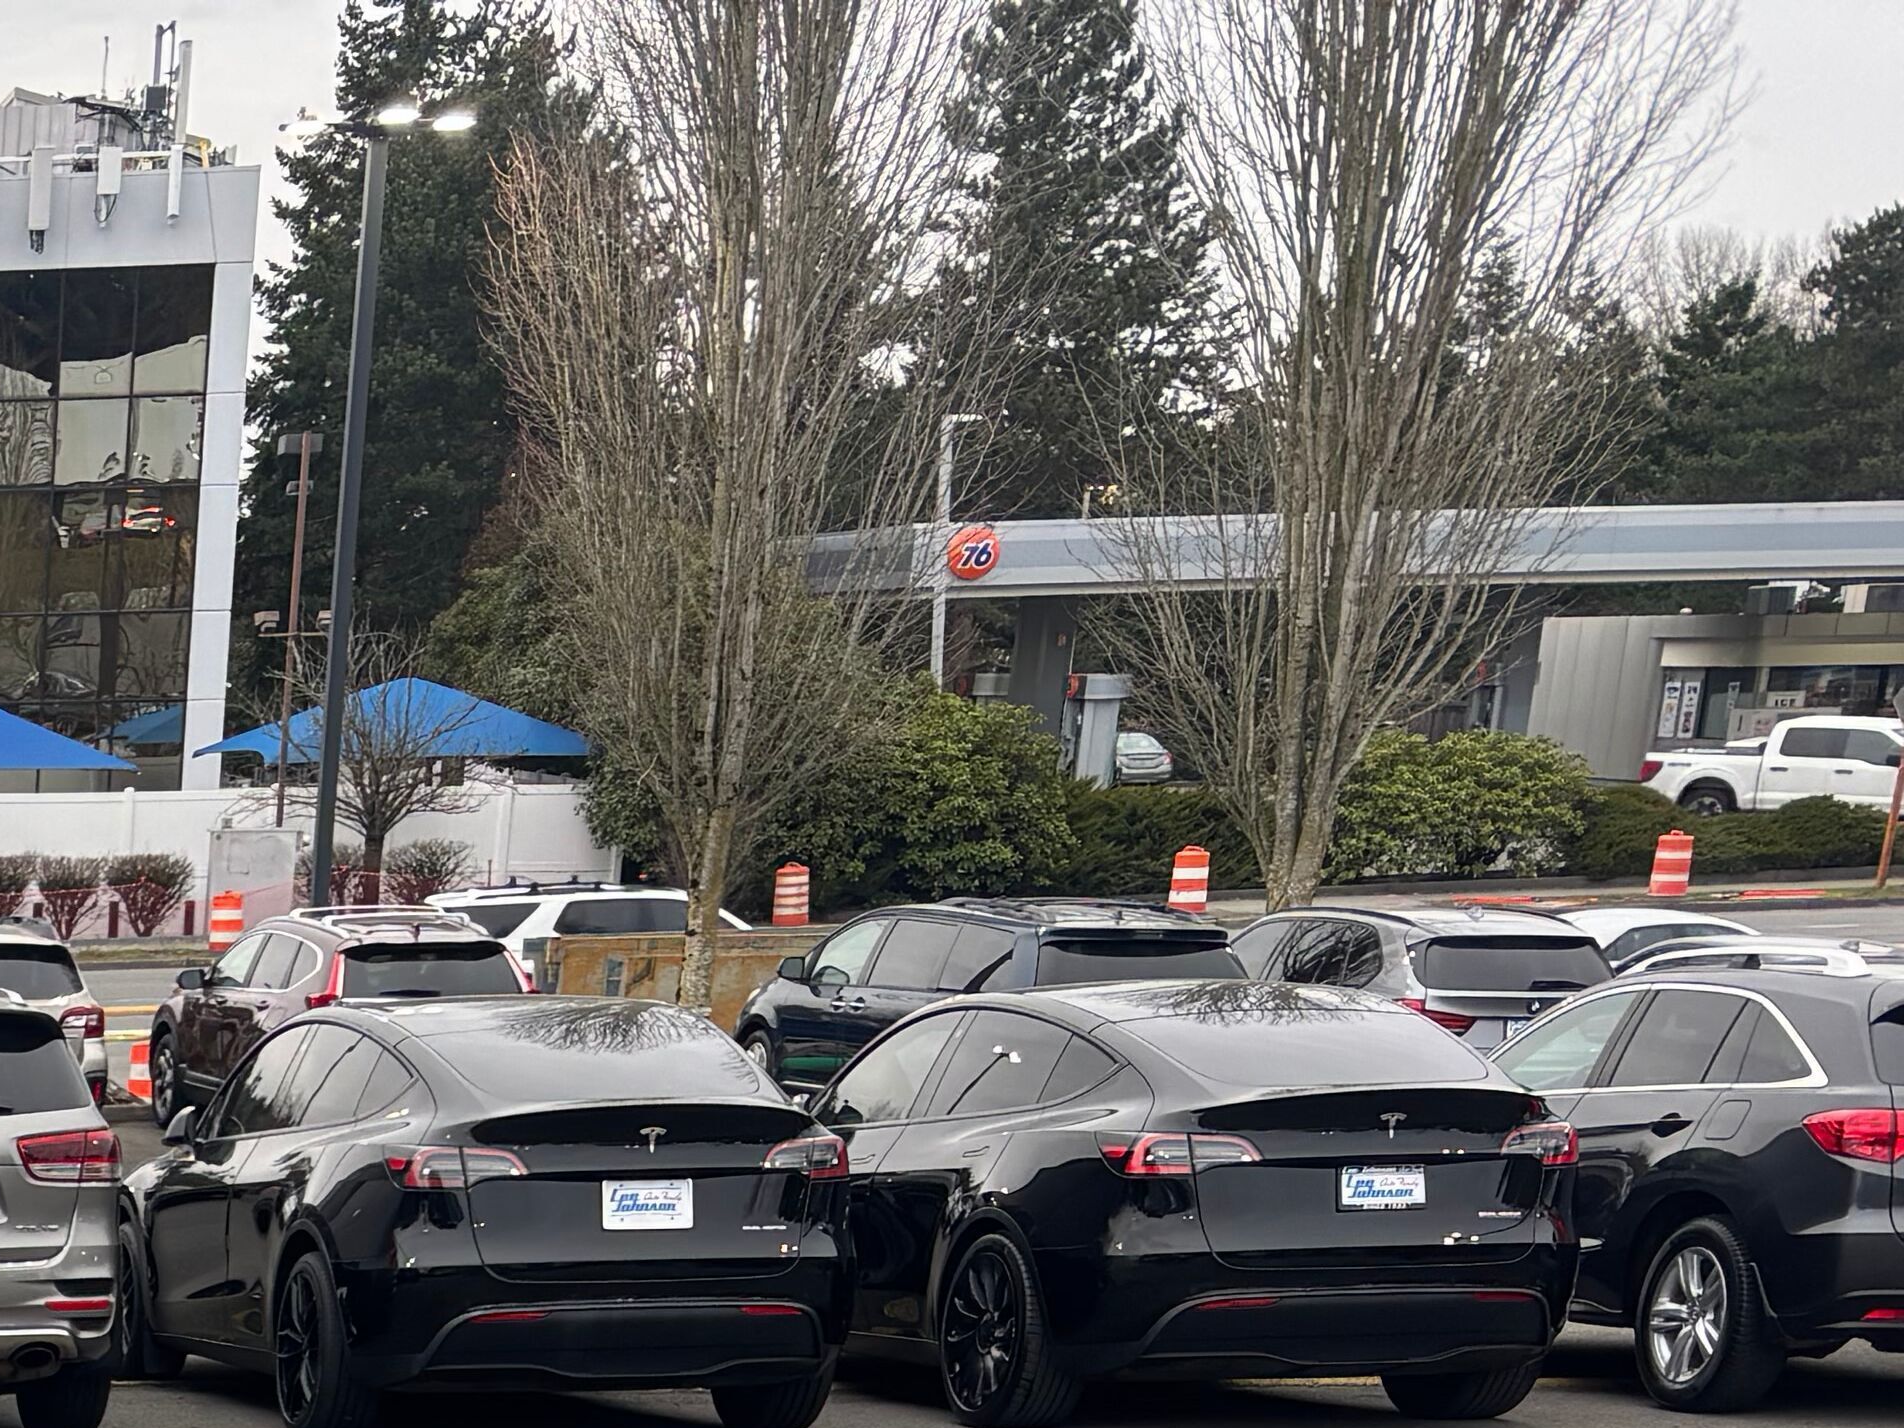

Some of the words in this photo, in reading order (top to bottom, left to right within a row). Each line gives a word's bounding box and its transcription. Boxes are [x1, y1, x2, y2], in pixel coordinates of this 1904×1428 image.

[957, 538, 995, 570] 76
[1346, 1188, 1414, 1199] Johnson
[611, 1201, 677, 1212] Johnson
